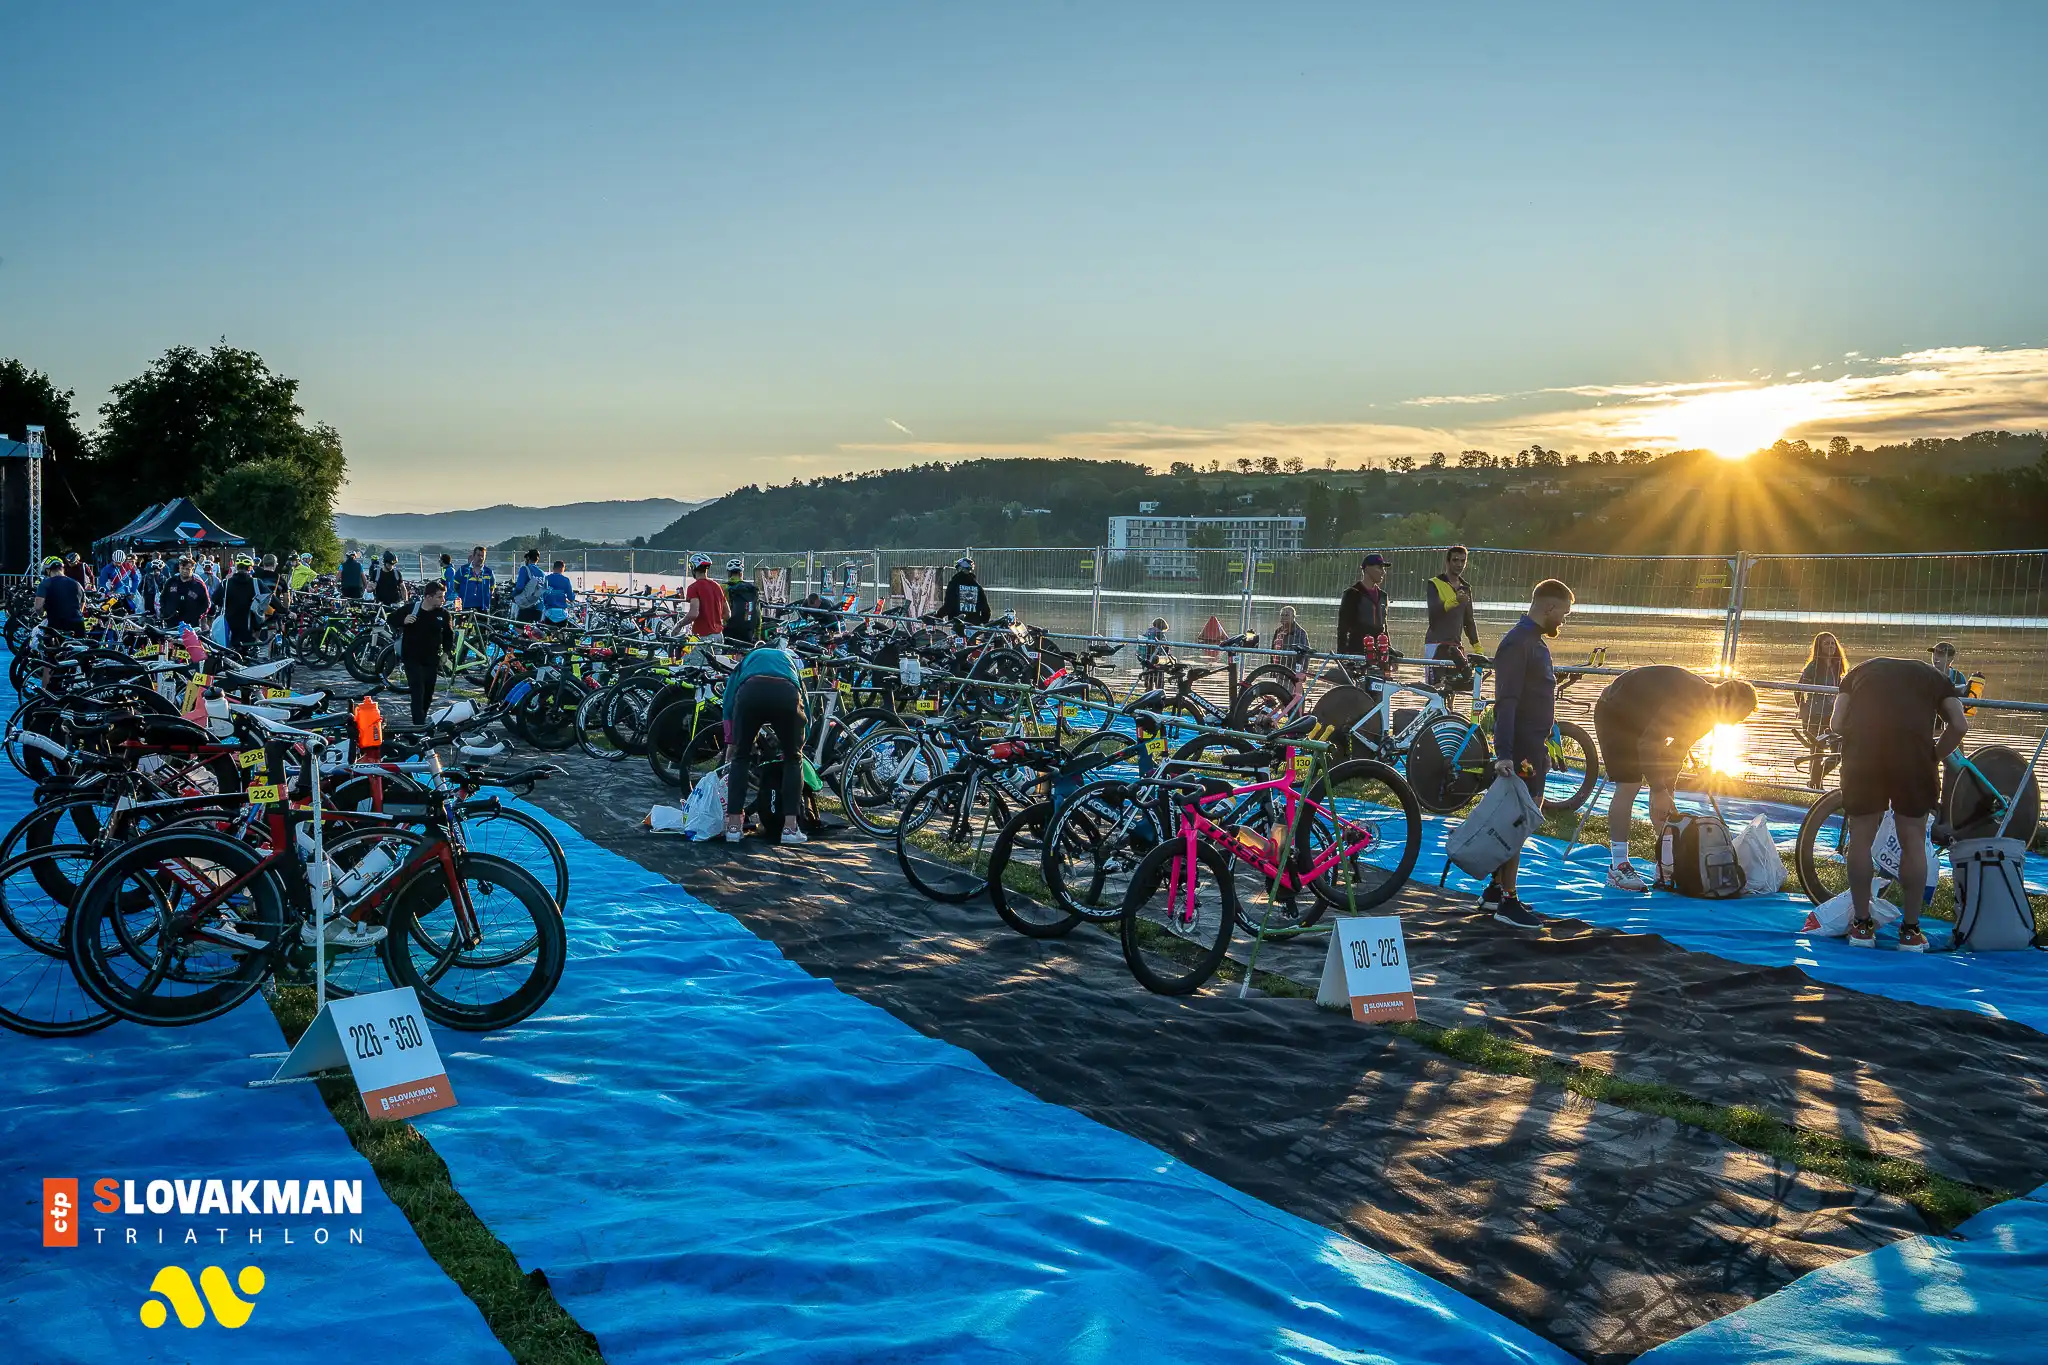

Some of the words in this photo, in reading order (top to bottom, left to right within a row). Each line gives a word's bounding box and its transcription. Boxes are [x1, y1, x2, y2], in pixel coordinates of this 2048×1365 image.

[271, 689, 287, 698] 231
[1187, 692, 1219, 715] ARGON
[243, 751, 265, 764] 228
[1296, 759, 1311, 767] 130
[253, 789, 275, 800] 226
[1879, 853, 1900, 871] 002
[1349, 940, 1371, 969] 130
[1378, 938, 1400, 967] 225
[1369, 1000, 1404, 1009] SLOVAKMAN
[349, 1022, 383, 1059] 226
[388, 1014, 423, 1051] 350
[388, 1086, 437, 1104] SLOVAKMAN
